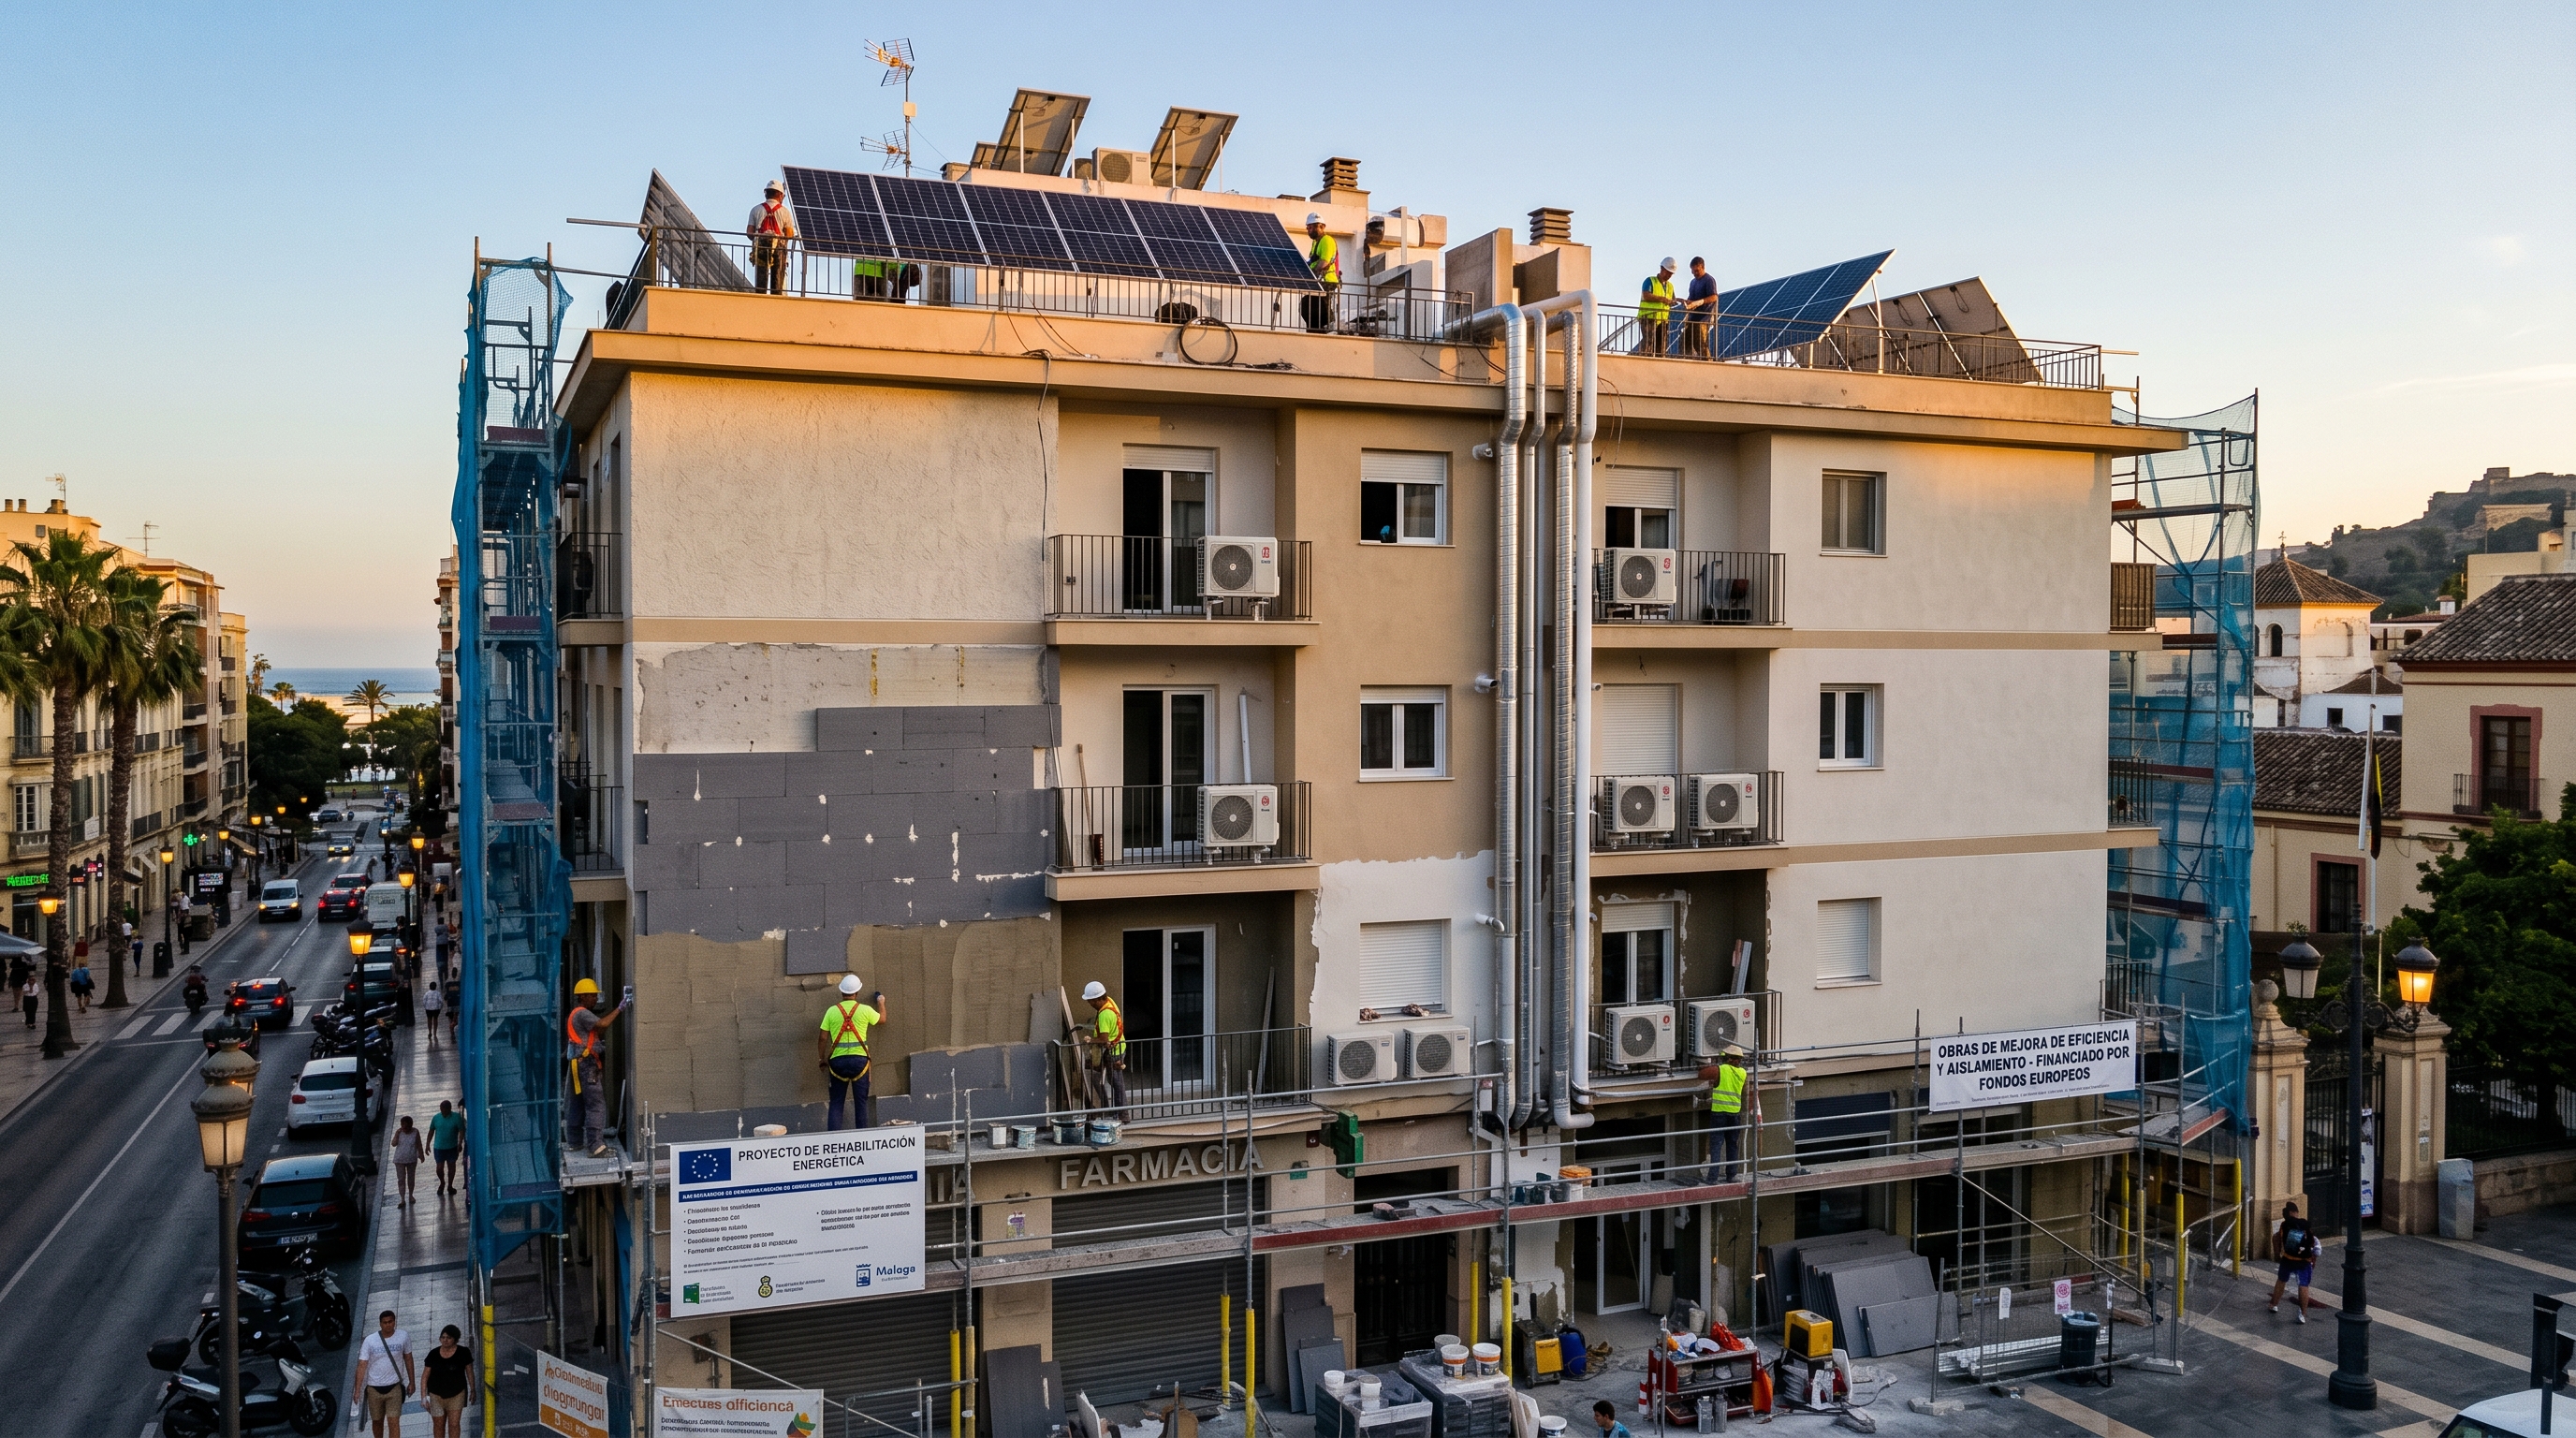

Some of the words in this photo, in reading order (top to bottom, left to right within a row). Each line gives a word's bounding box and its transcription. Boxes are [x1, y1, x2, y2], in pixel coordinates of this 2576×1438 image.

[1939, 1043, 1979, 1058] OBRAS
[1982, 1041, 1997, 1054] DE
[2000, 1036, 2048, 1053] MEJORA
[2050, 1034, 2065, 1048] DE
[2068, 1029, 2130, 1047] EFICIENCIA
[1937, 1063, 1944, 1076] Y
[1947, 1056, 2027, 1076] AISLAMIENTO
[2036, 1049, 2104, 1067] FINANCIADO
[2107, 1046, 2130, 1060] POR
[1979, 1074, 2027, 1091] FONDOS
[2029, 1066, 2091, 1085] EUROPEOS
[739, 1146, 801, 1161] PROYECTO
[805, 1145, 819, 1156] DE
[823, 1136, 915, 1154] REHABILITACIÓN
[793, 1155, 864, 1170] ENERGÉTICA
[1061, 1142, 1264, 1190] FARMACIA
